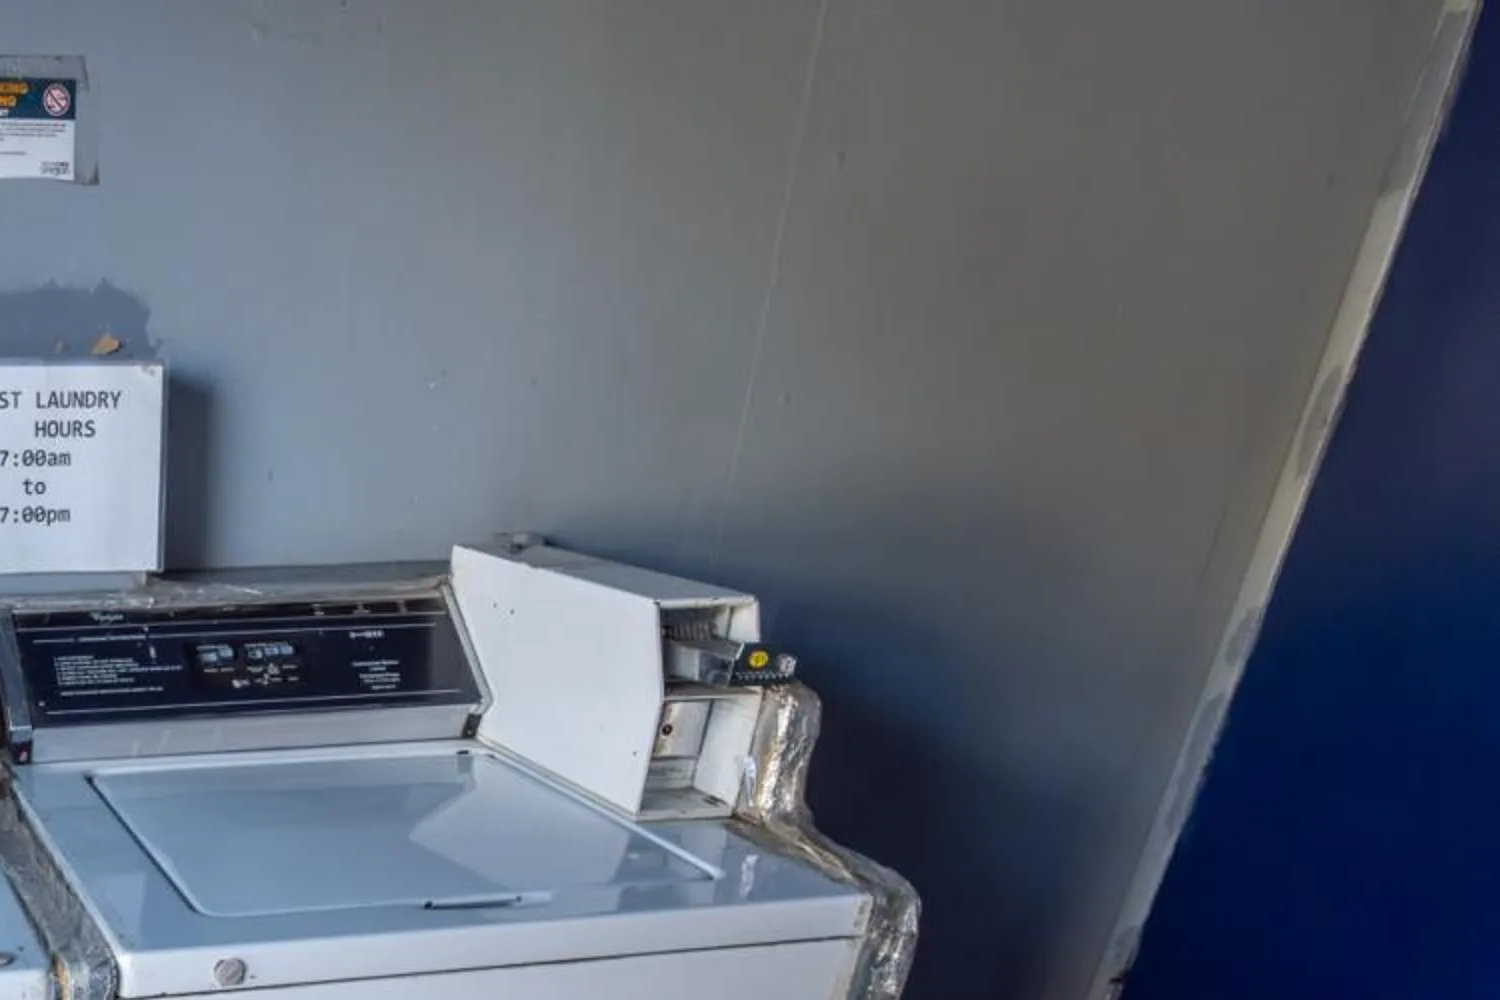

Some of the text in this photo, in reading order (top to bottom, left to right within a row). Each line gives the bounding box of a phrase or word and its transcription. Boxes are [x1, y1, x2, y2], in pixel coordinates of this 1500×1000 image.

[36, 391, 121, 408] LAUNDRY
[35, 420, 95, 438] HOURS
[0, 449, 70, 466] 7:00am
[23, 479, 46, 495] to
[0, 506, 70, 526] 7:00pm
